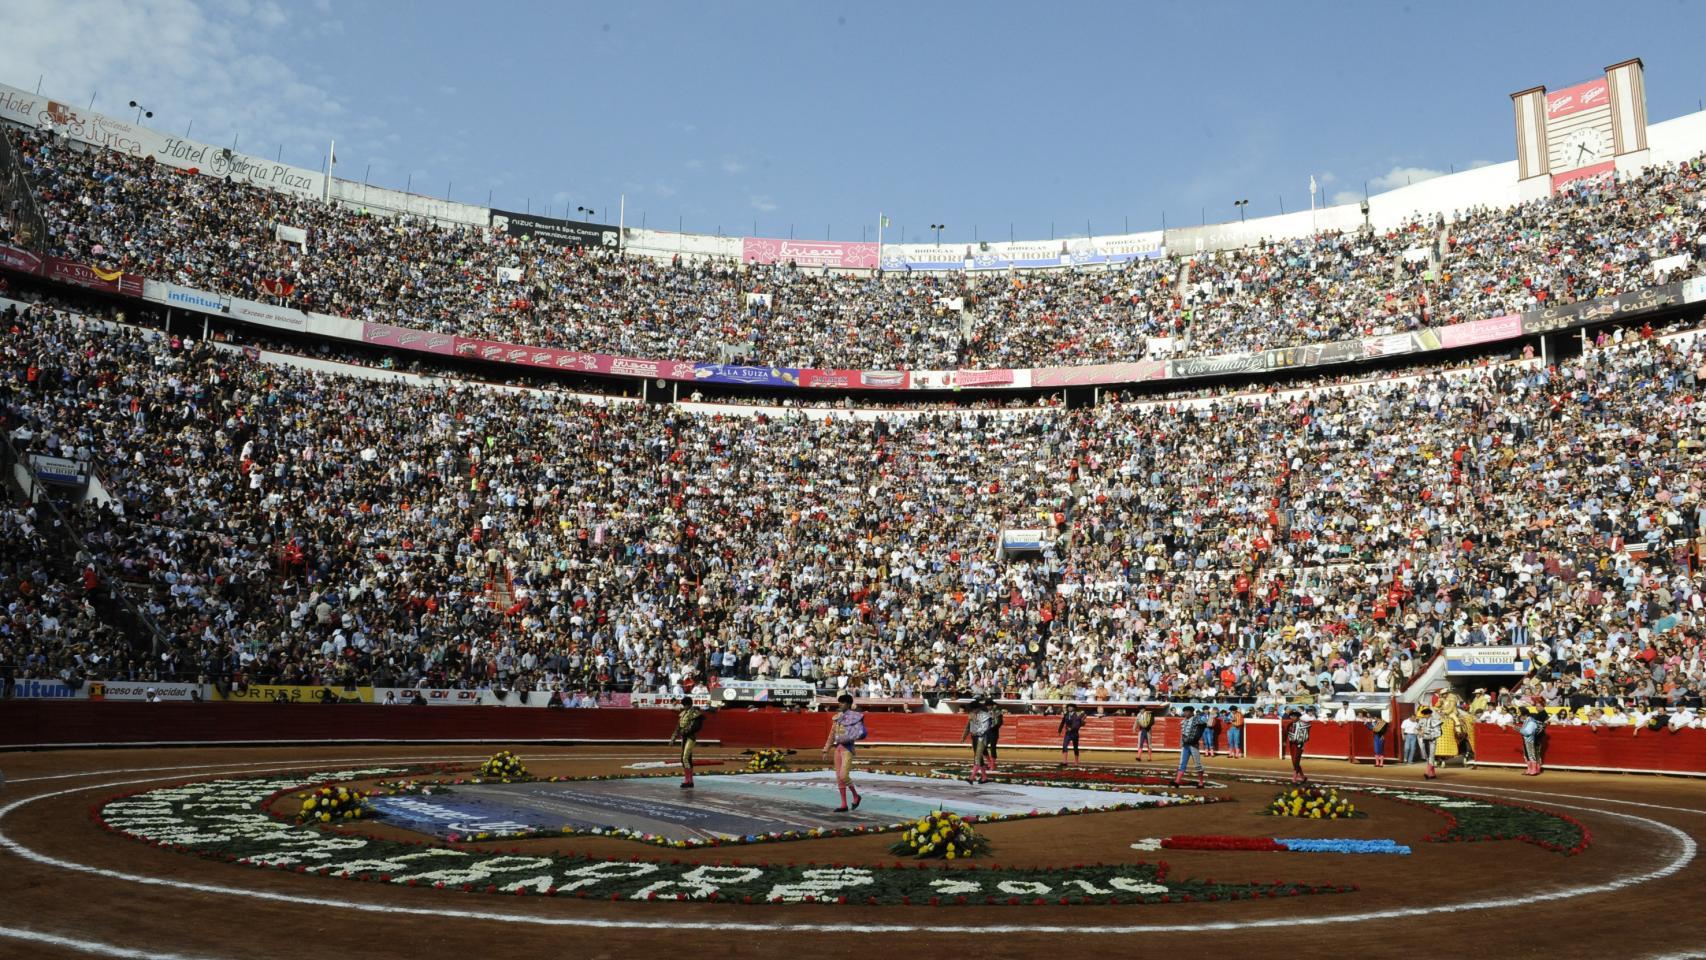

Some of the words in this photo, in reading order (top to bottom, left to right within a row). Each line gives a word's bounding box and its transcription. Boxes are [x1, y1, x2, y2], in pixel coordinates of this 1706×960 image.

[0, 91, 35, 116] Hotel
[158, 137, 208, 164] Hotel
[272, 165, 312, 189] Plaza
[1524, 314, 1575, 330] CALMEX
[727, 369, 738, 377] LA
[742, 369, 769, 378] SUIZA
[132, 687, 144, 696] de
[929, 876, 1169, 895] 2016
